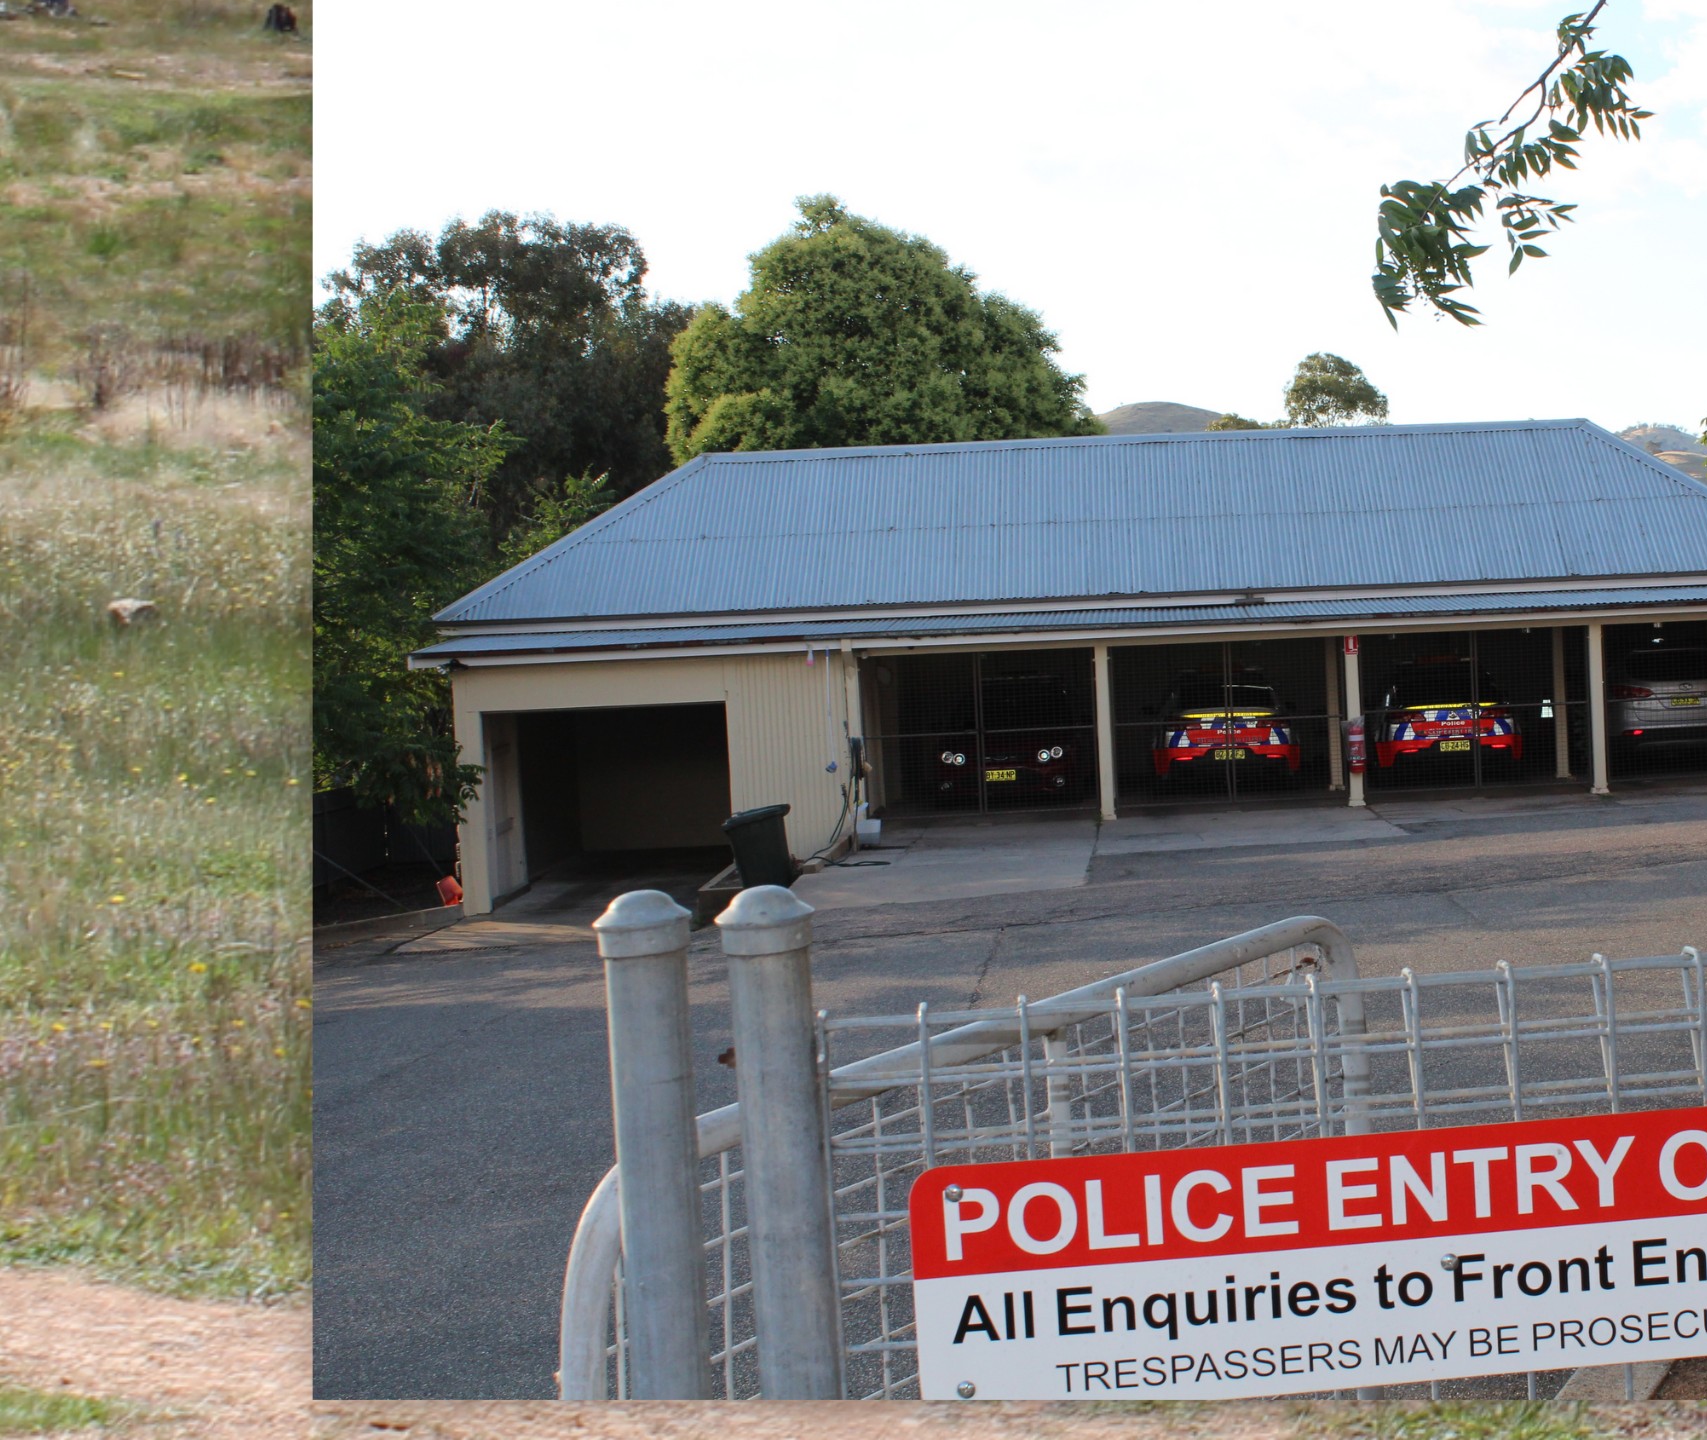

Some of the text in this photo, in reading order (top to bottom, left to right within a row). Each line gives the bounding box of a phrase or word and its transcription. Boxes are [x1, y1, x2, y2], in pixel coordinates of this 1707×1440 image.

[943, 1164, 1299, 1262] POLICE
[1326, 1136, 1635, 1231] ENTRY
[952, 1290, 1036, 1345] All
[1056, 1270, 1357, 1341] Enquiries
[1373, 1263, 1433, 1309] to
[1454, 1244, 1615, 1303] Front
[1056, 1339, 1362, 1393] TRESPASSERS
[1374, 1330, 1457, 1367] MAY
[1470, 1324, 1521, 1358] BE
